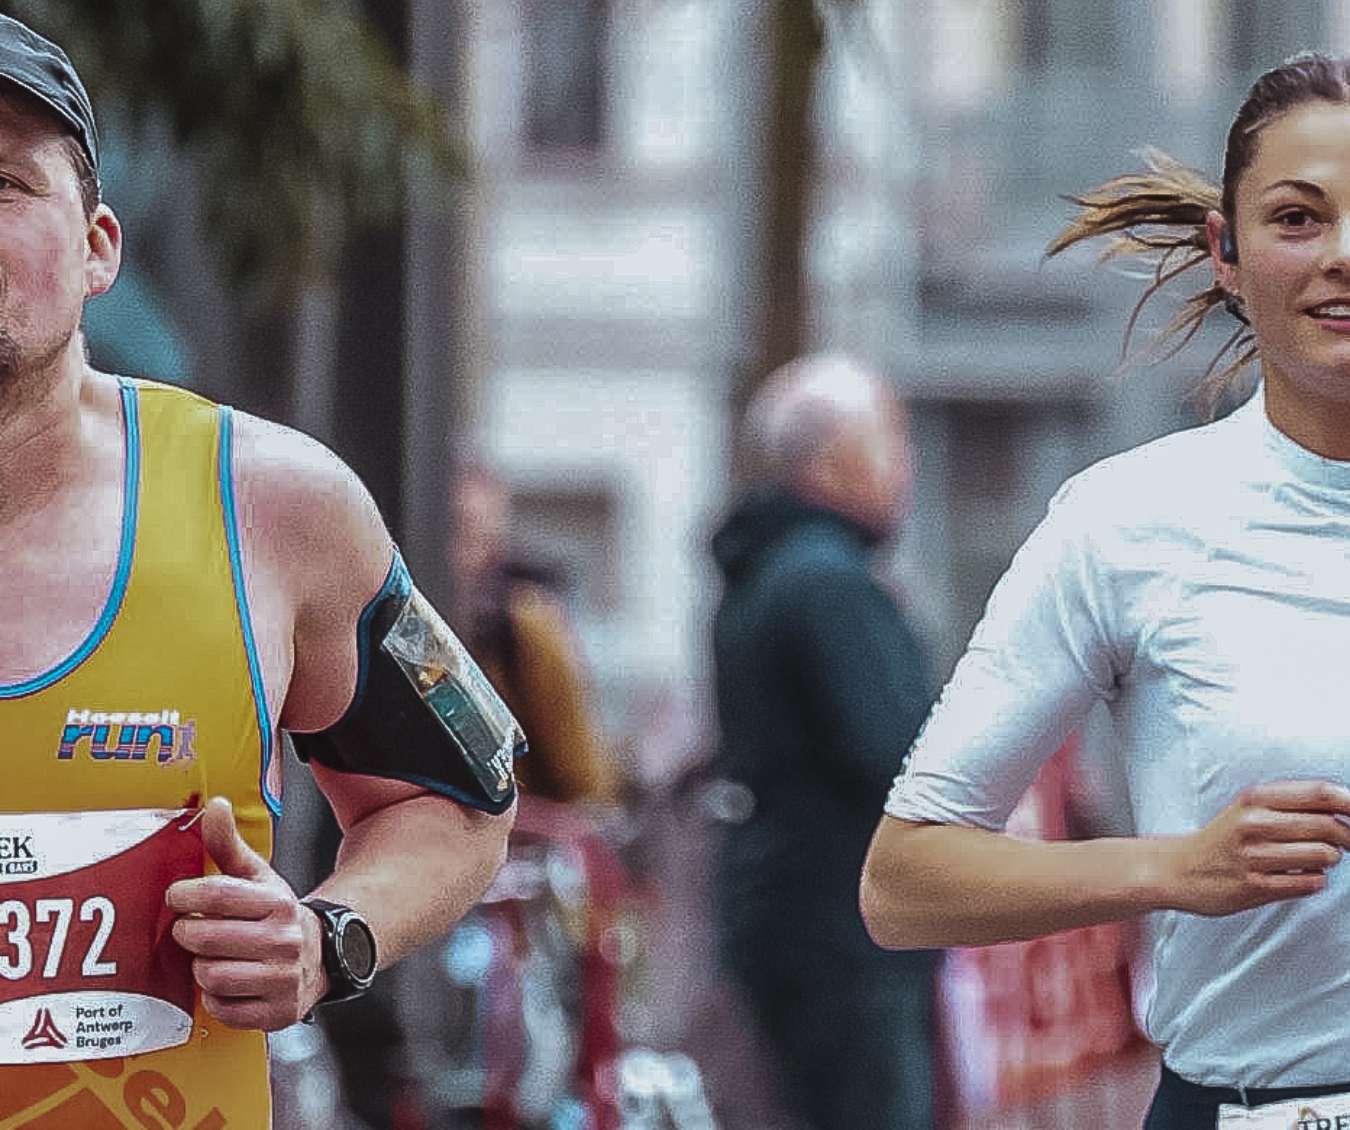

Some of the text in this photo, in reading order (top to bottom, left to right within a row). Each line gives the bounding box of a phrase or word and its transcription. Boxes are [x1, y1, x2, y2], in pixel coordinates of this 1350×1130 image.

[0, 896, 117, 980] 372
[76, 1004, 123, 1019] Port of
[76, 1020, 133, 1033] Antwerp
[76, 1036, 122, 1049] Bruges
